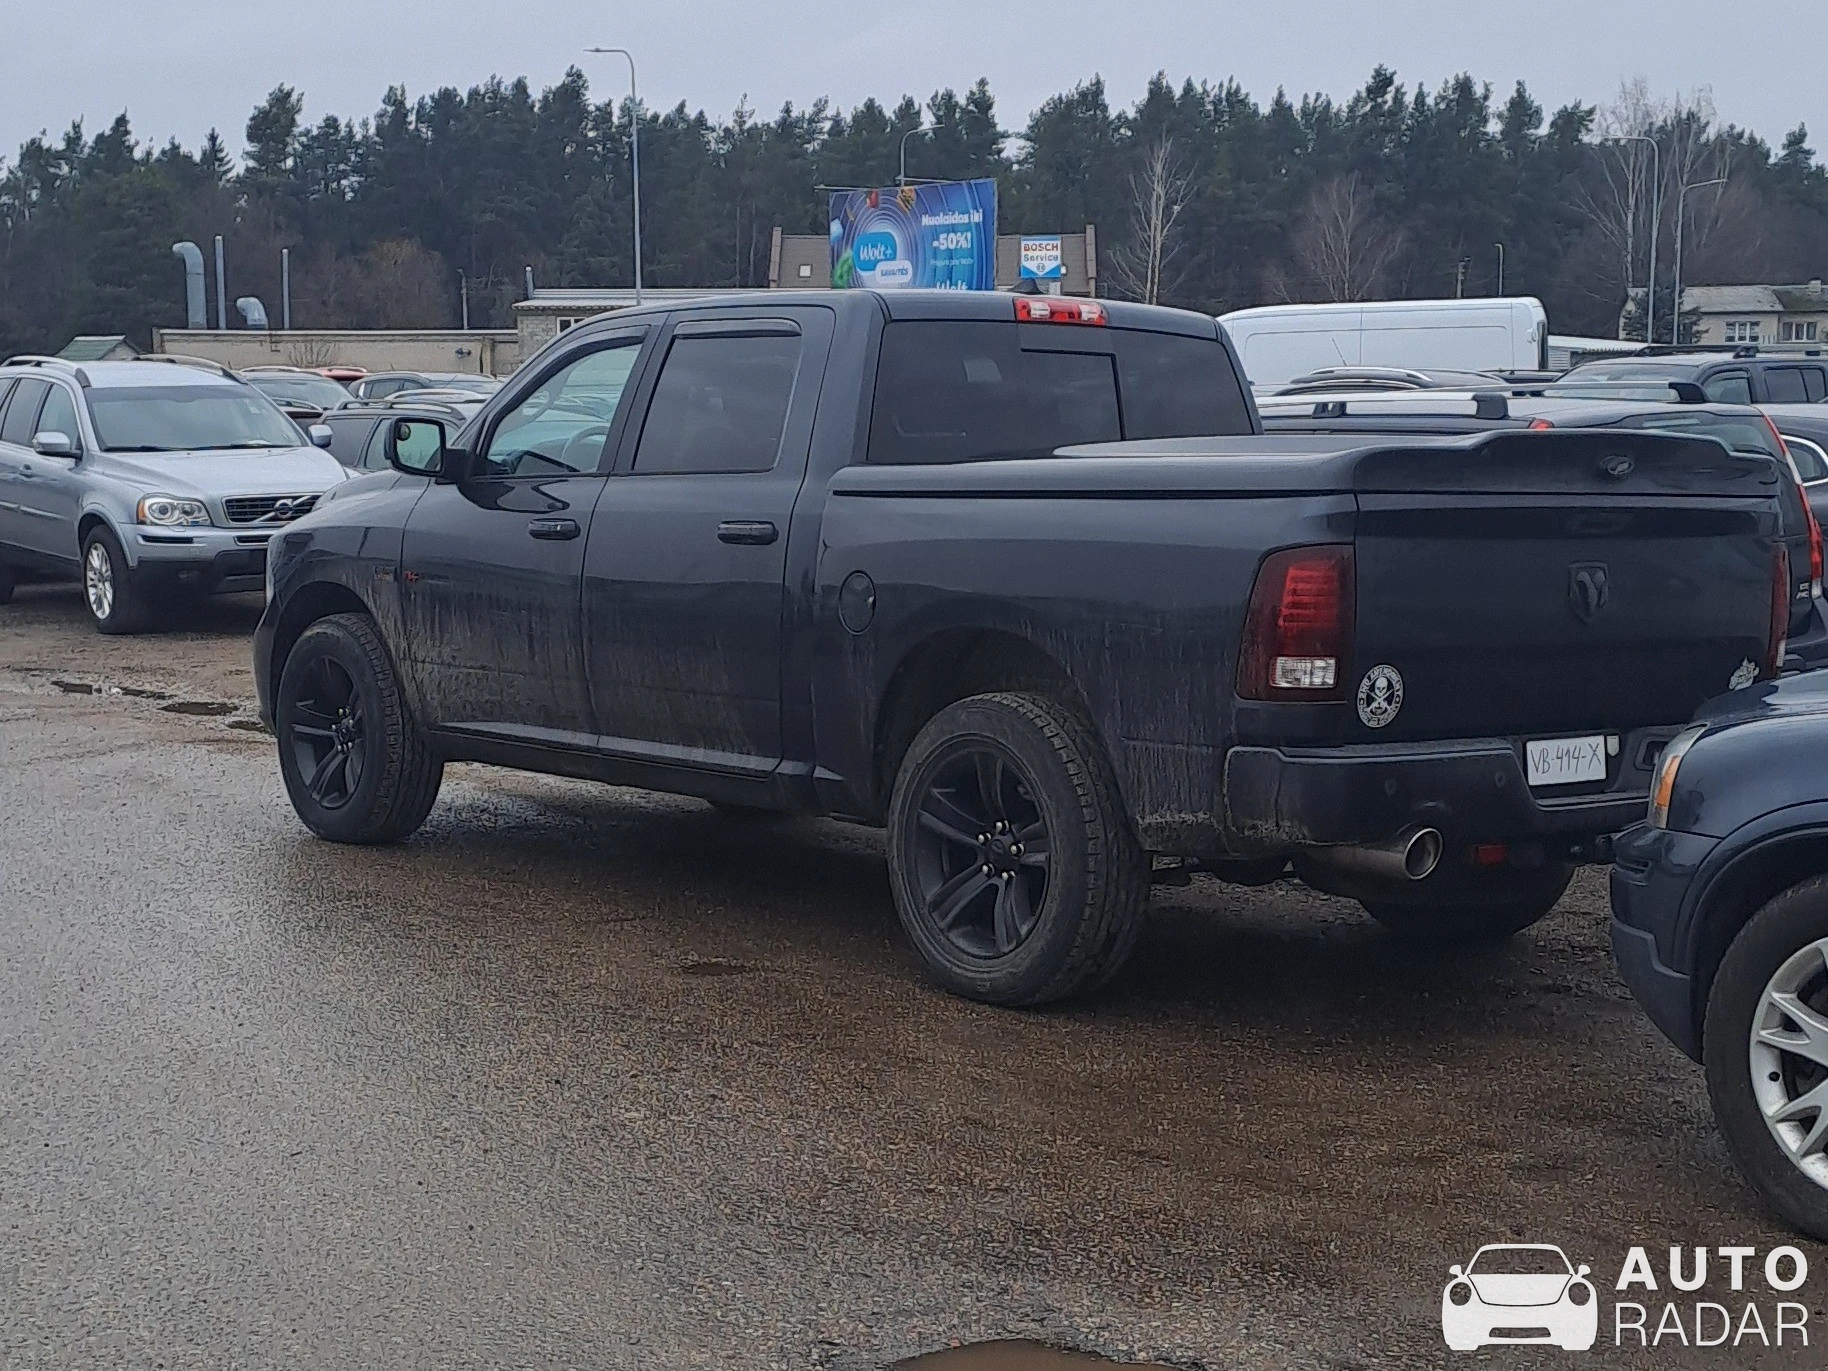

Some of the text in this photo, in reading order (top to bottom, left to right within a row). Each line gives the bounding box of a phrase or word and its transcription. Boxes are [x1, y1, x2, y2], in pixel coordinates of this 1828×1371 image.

[932, 231, 972, 250] -50%!
[860, 242, 893, 260] Wolt+
[1023, 243, 1059, 252] BOSCH
[1023, 253, 1059, 262] Service
